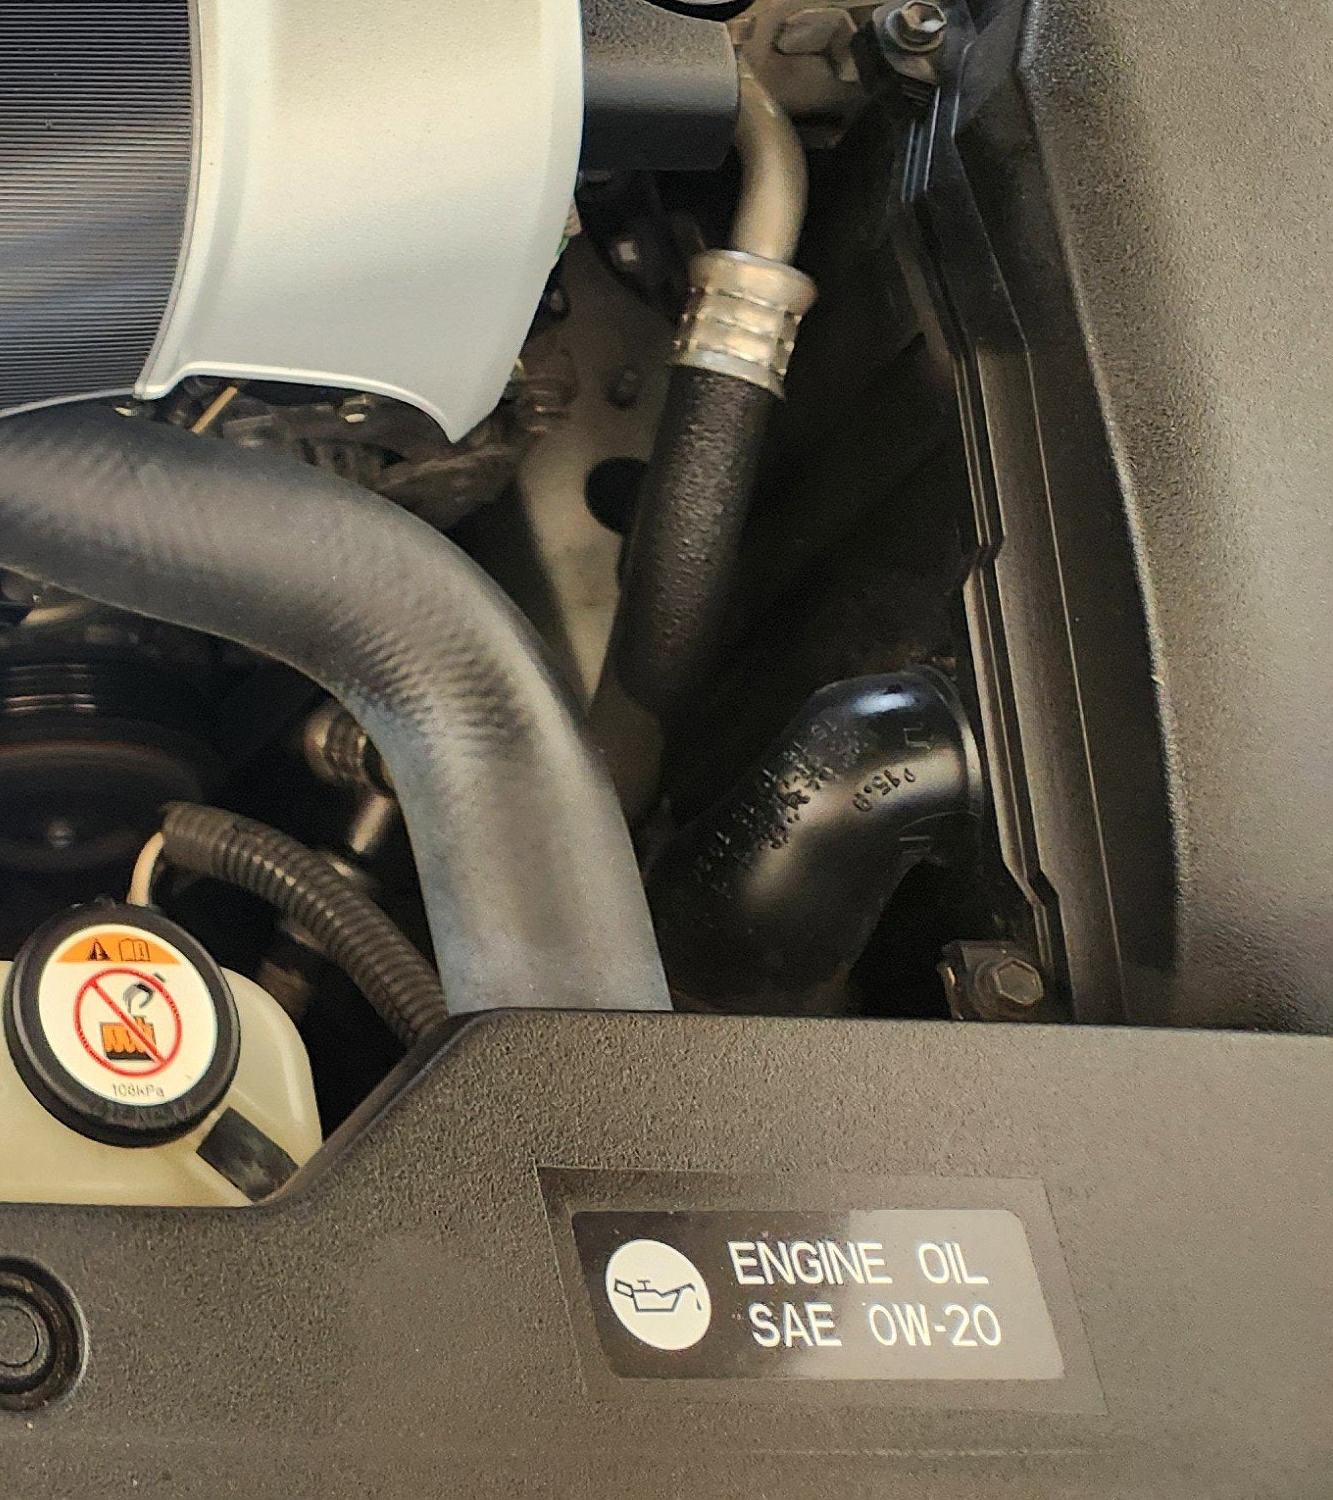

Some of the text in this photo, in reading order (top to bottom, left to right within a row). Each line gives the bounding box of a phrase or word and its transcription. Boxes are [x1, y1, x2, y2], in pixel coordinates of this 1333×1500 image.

[726, 1240, 990, 1286] ENGINE OIL
[747, 1302, 1002, 1348] SAE 0W-20
